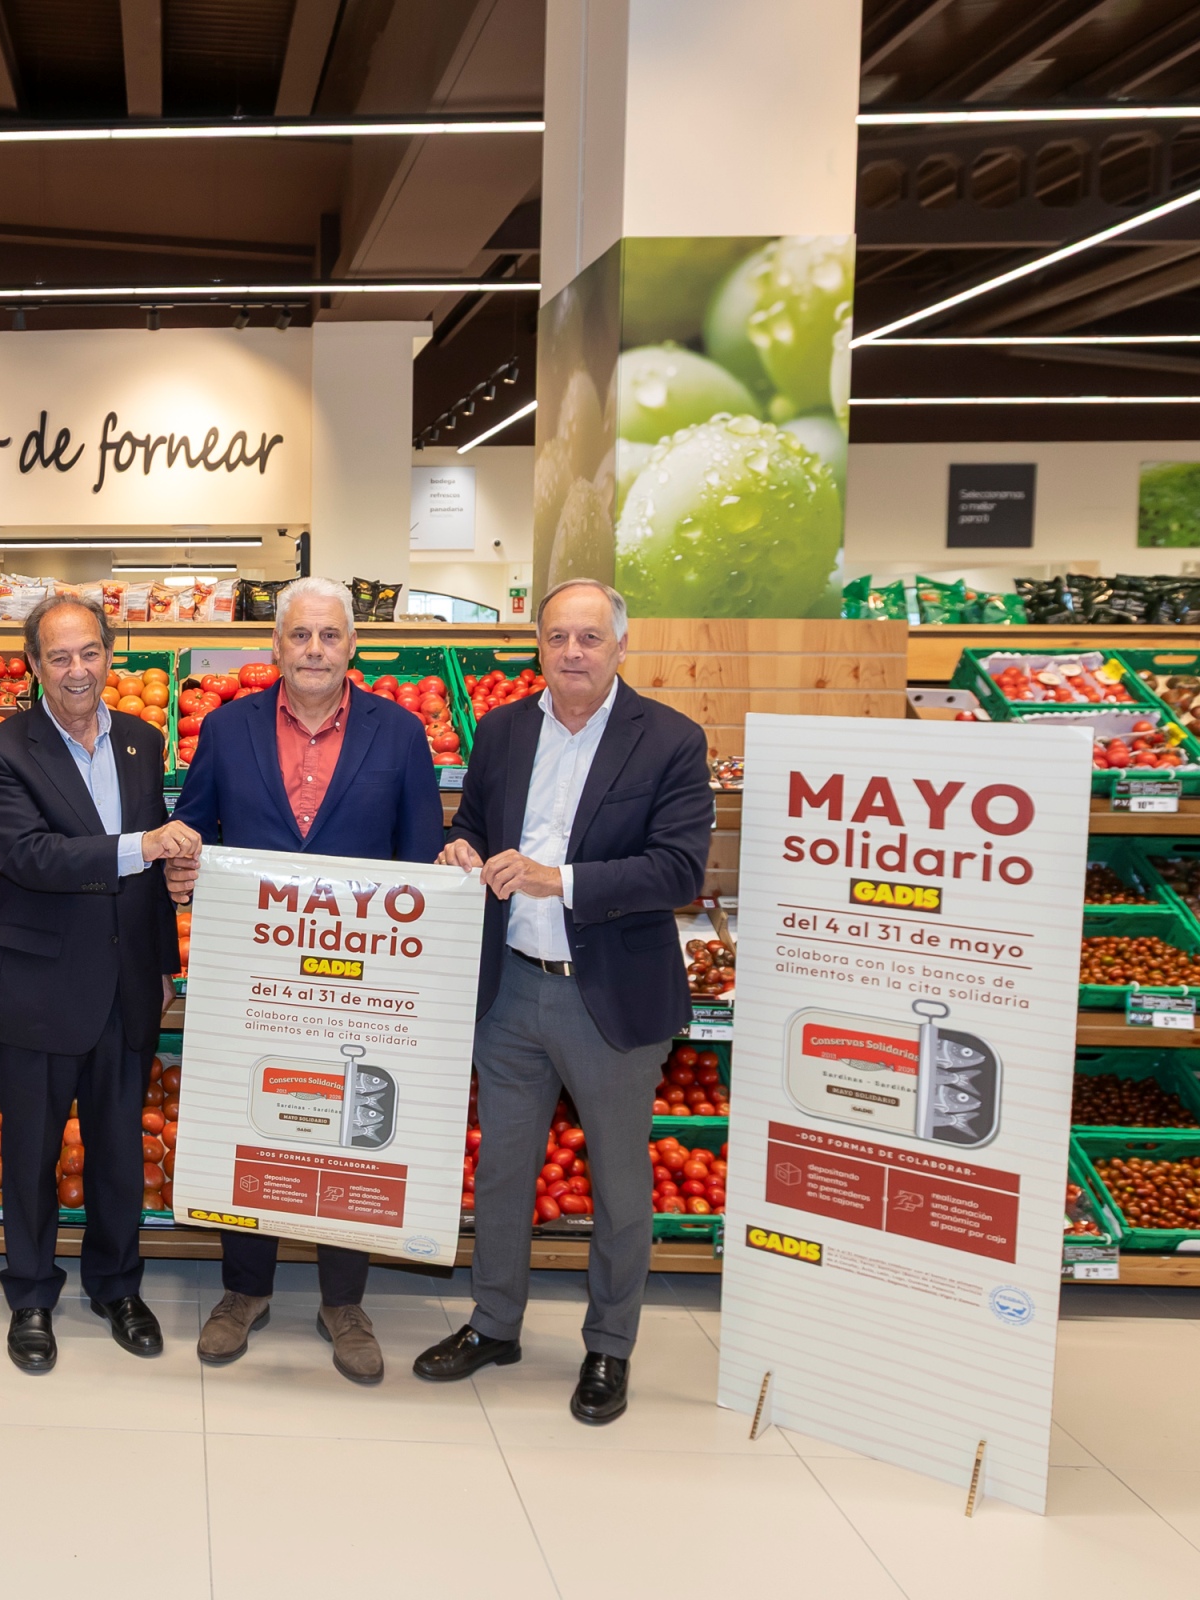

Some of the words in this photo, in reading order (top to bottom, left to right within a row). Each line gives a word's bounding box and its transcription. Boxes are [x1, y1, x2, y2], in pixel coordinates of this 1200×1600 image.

[19, 410, 85, 474] de
[93, 411, 284, 494] fornear
[788, 771, 1035, 836] MAYO
[782, 828, 1032, 885] solidario
[257, 875, 425, 922] MAYO
[854, 881, 940, 909] GADIS
[252, 917, 422, 957] solidario
[782, 912, 816, 930] del
[825, 917, 839, 933] 4
[847, 921, 868, 937] al
[877, 923, 900, 941] 31
[910, 928, 940, 946] de
[950, 937, 1023, 959] mayo
[303, 958, 362, 978] GADIS
[776, 945, 848, 965] Colabora
[855, 958, 884, 970] con
[891, 961, 914, 974] los
[922, 965, 984, 984] bancos
[992, 976, 1014, 989] de
[251, 982, 276, 996] del
[282, 985, 292, 998] 4
[297, 988, 313, 1000] al
[318, 989, 334, 1002] 31
[340, 991, 361, 1005] de
[367, 997, 414, 1011] mayo
[775, 961, 853, 982] alimentos
[860, 975, 879, 985] en
[887, 976, 901, 989] la
[908, 981, 940, 995] cita
[949, 988, 1028, 1008] solidaria
[244, 1021, 301, 1034] alimentos
[324, 1028, 333, 1038] la
[338, 1030, 360, 1040] cita
[365, 1034, 416, 1046] solidaria
[245, 1008, 297, 1021] Colabora
[302, 1016, 322, 1024] con
[327, 1016, 343, 1026] los
[348, 1018, 389, 1031] bancos
[394, 1023, 408, 1032] de
[810, 1036, 865, 1049] Conservas
[269, 1074, 306, 1086] Conservas
[279, 1153, 310, 1162] FORMAS
[327, 1159, 379, 1169] COLABORAR-
[796, 1133, 822, 1143] -DOS
[827, 1138, 873, 1154] FORMAS
[878, 1149, 892, 1158] DE
[898, 1153, 975, 1175] COLABORAR-
[190, 1210, 256, 1228] GADIS
[749, 1229, 821, 1261] GADIS
